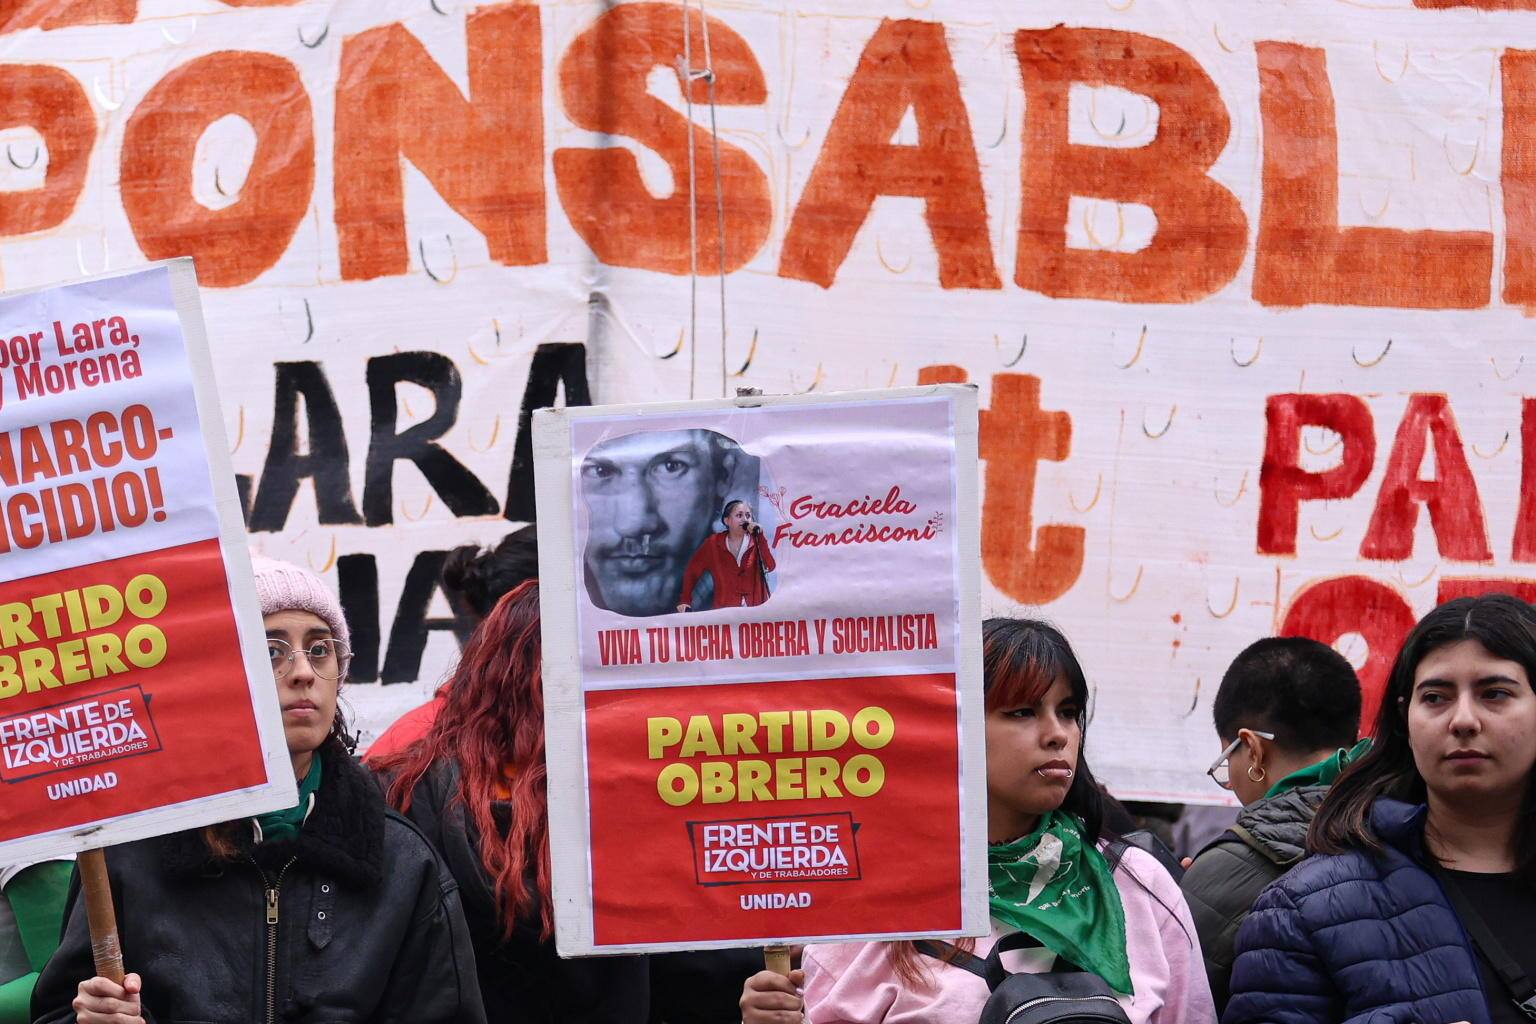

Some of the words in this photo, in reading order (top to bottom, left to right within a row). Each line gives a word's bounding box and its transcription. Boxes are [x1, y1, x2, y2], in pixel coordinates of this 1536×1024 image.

[53, 315, 140, 358] Lara,
[13, 349, 143, 401] Morena
[236, 342, 592, 532] ARA
[1257, 391, 1536, 564] PA
[789, 485, 917, 520] Graciela
[771, 519, 936, 550] Francisconi
[597, 629, 642, 666] VIVA
[646, 627, 670, 663] TU
[675, 624, 734, 662] LUCHA
[738, 620, 810, 659] OBRERA
[814, 619, 826, 655] Y
[832, 613, 938, 655] SOCIALISTA
[104, 700, 133, 721] DE
[2, 719, 147, 769] IZQUIERDA
[646, 706, 895, 760] PARTIDO
[52, 759, 60, 768] Y
[62, 757, 75, 767] DE
[77, 741, 149, 763] TRABAJADORES
[47, 771, 119, 801] UNIDAD
[657, 753, 885, 807] OBRERO
[703, 821, 807, 848] FRENTE
[810, 825, 839, 844] DE
[704, 845, 849, 872] IZQUIERDA
[751, 871, 757, 879] Y
[759, 871, 772, 879] DE
[774, 867, 849, 878] TRABAJADORES
[740, 892, 812, 911] UNIDAD
